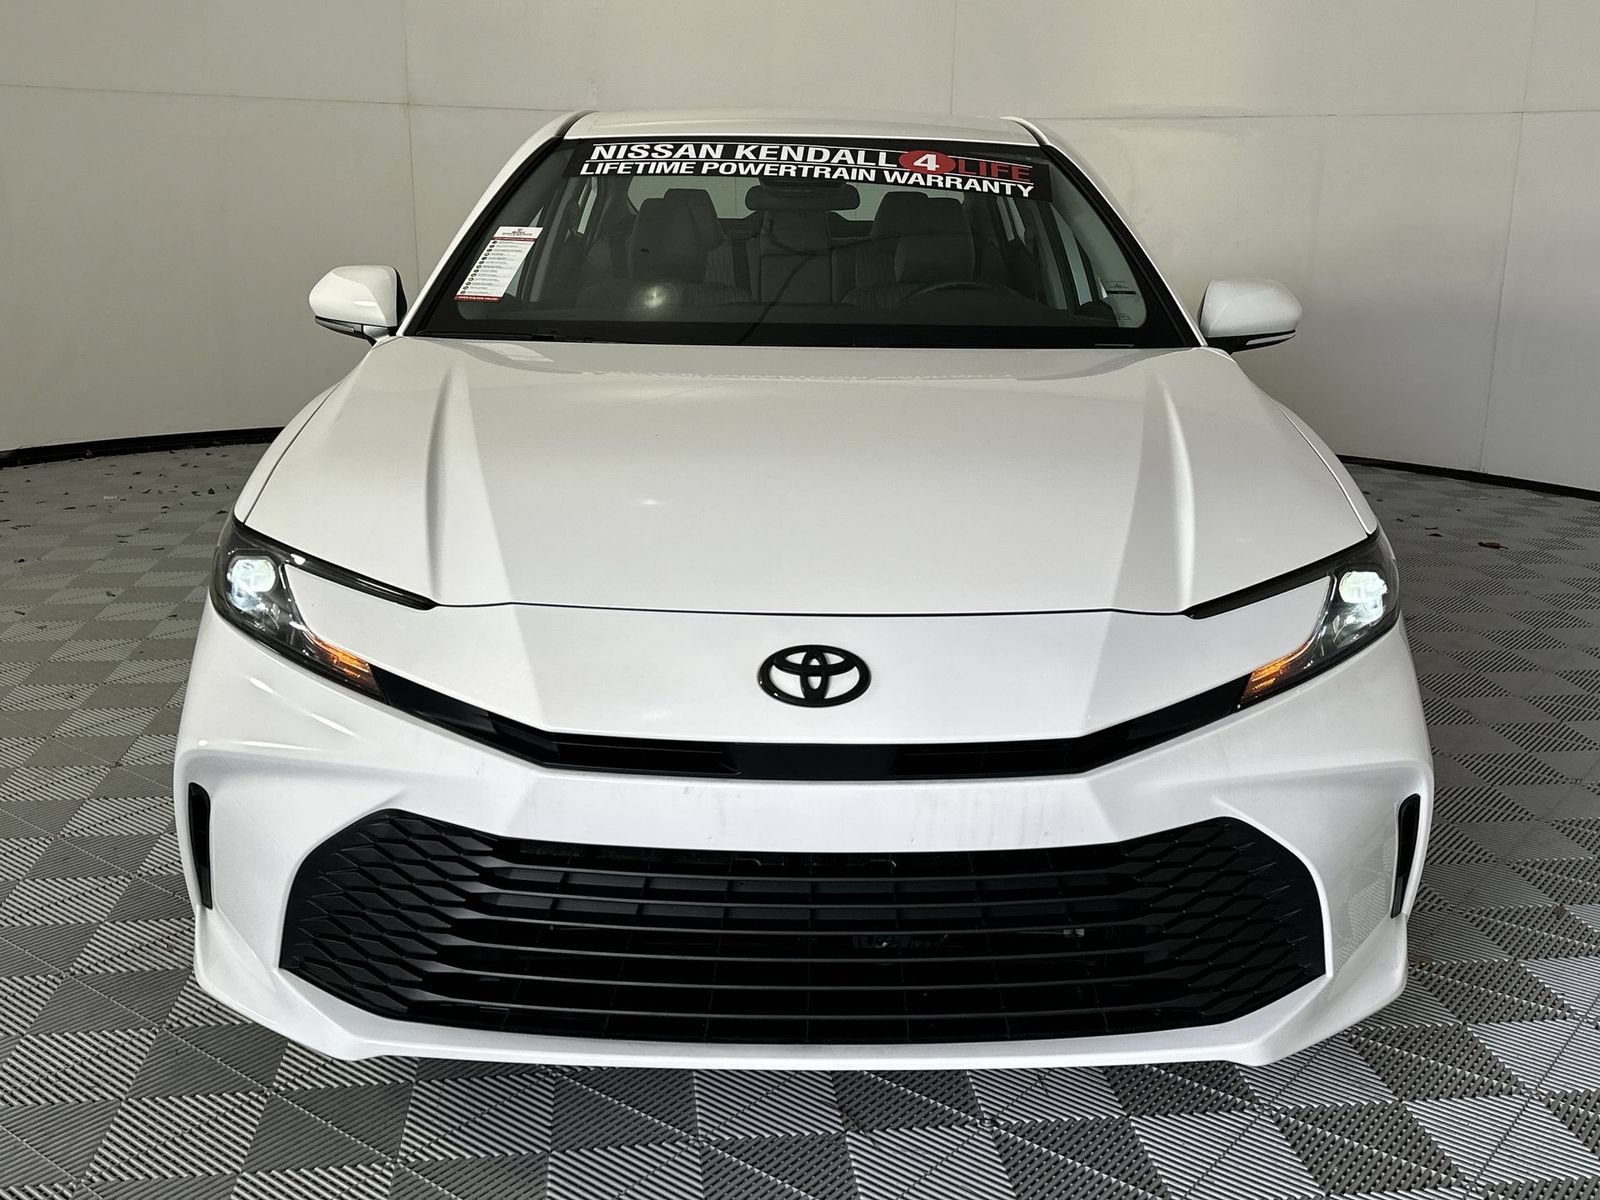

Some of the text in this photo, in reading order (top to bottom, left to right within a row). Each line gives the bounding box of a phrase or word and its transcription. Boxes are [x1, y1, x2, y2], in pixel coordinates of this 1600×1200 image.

[579, 161, 1034, 198] LIFETIME POWERTRAIN WARRANTY
[590, 143, 1031, 182] NISSAN KENDALL 4 LIFE
